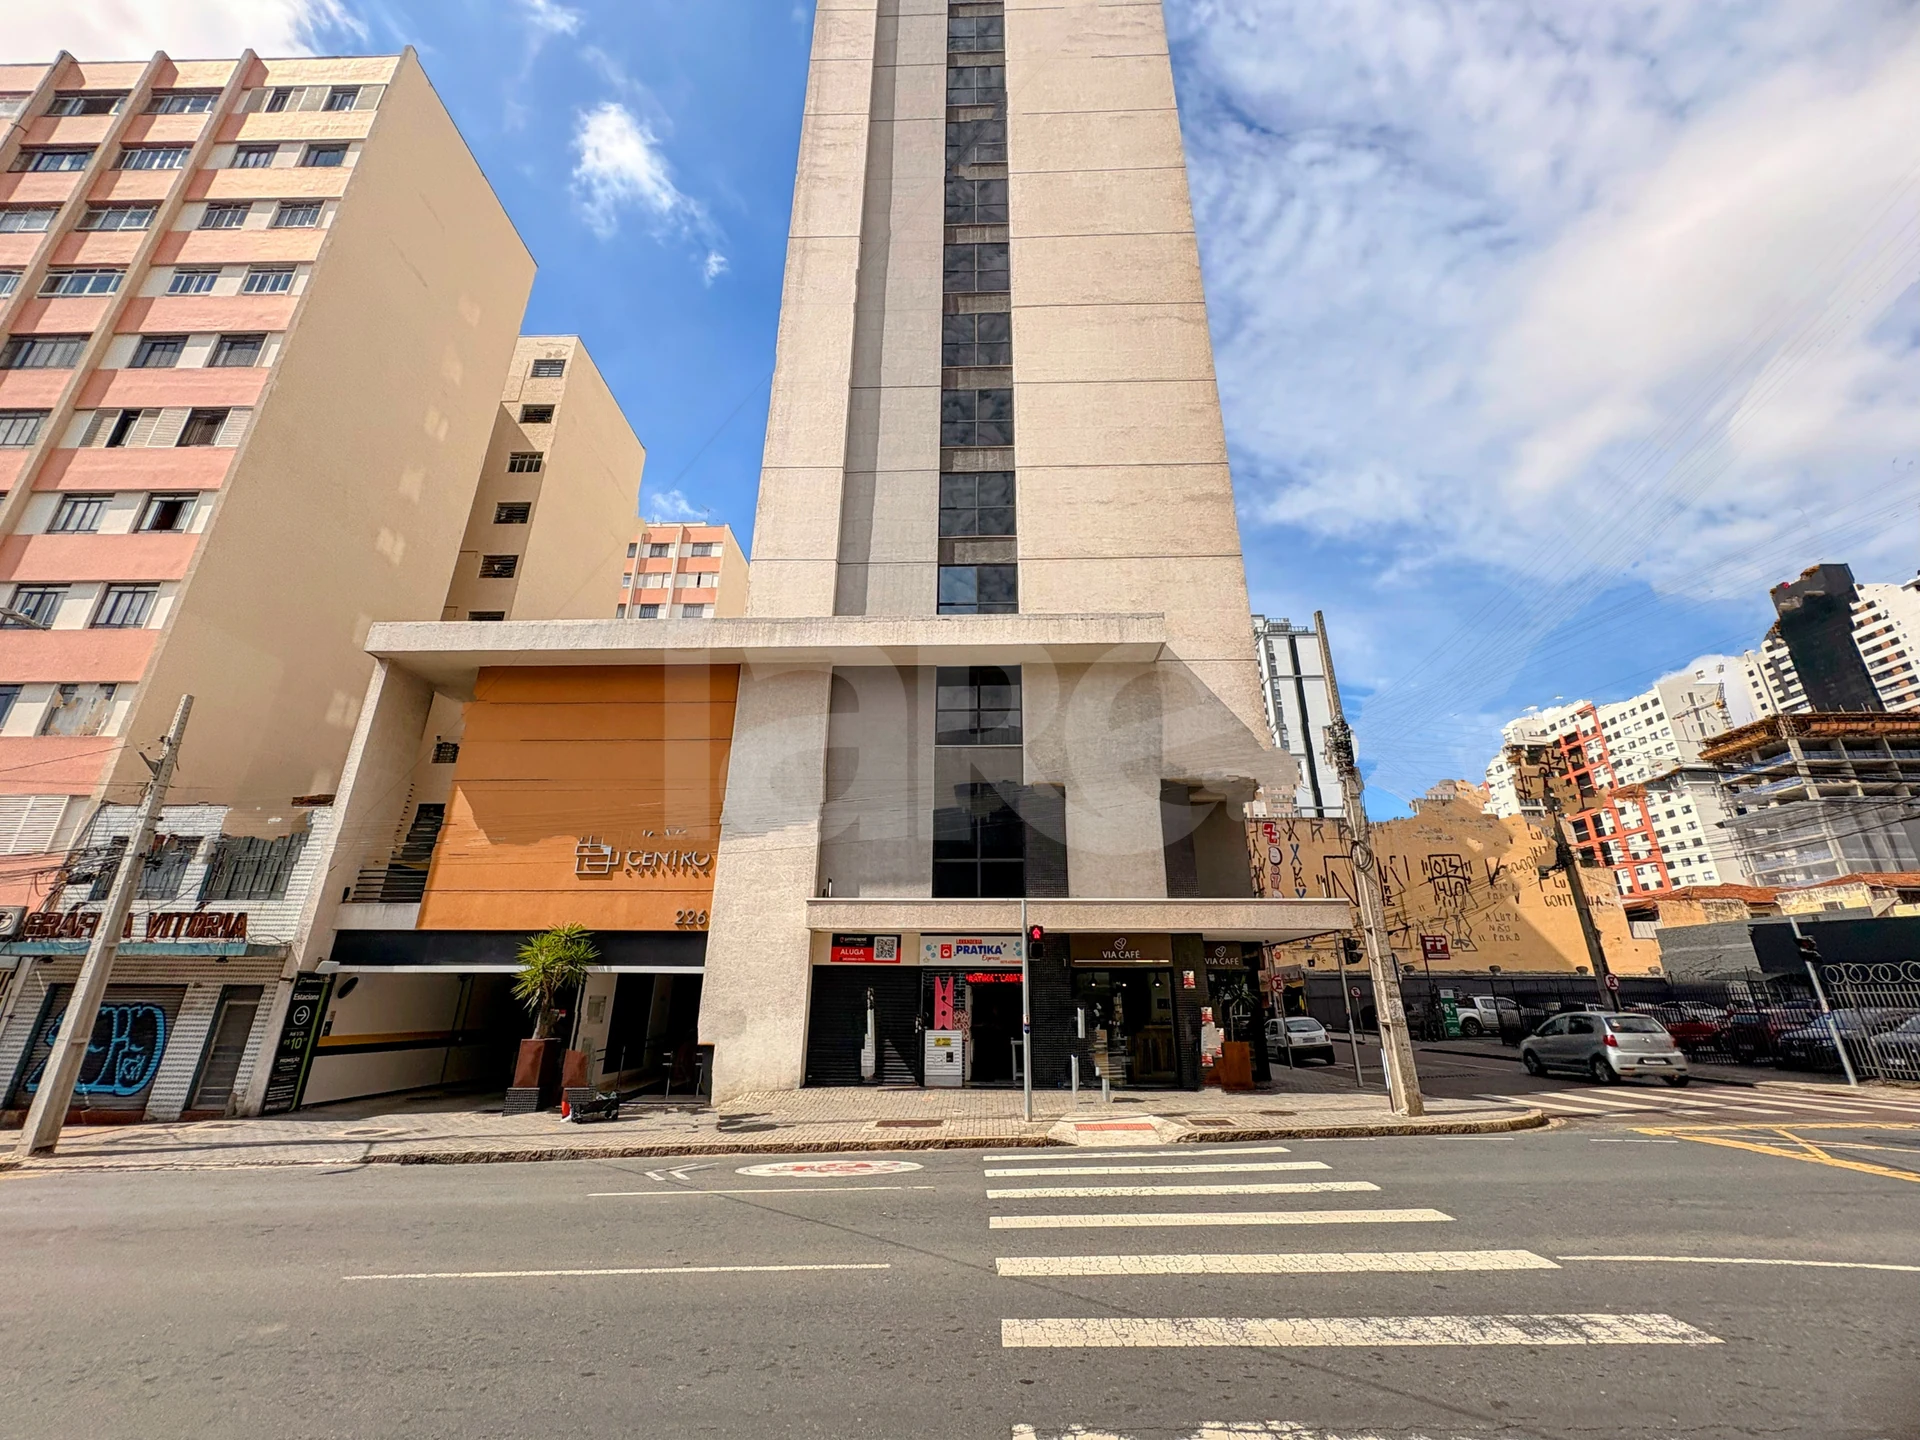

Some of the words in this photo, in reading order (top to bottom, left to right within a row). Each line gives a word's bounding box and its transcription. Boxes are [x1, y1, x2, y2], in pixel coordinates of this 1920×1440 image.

[626, 850, 711, 866] CENTRO
[146, 902, 248, 939] VITÓRIA
[674, 909, 707, 925] 226
[956, 945, 1002, 954] PRATIKA
[1102, 951, 1117, 959] VIA
[1118, 950, 1141, 959] CAFÉ
[1219, 957, 1239, 965] CAFÉ
